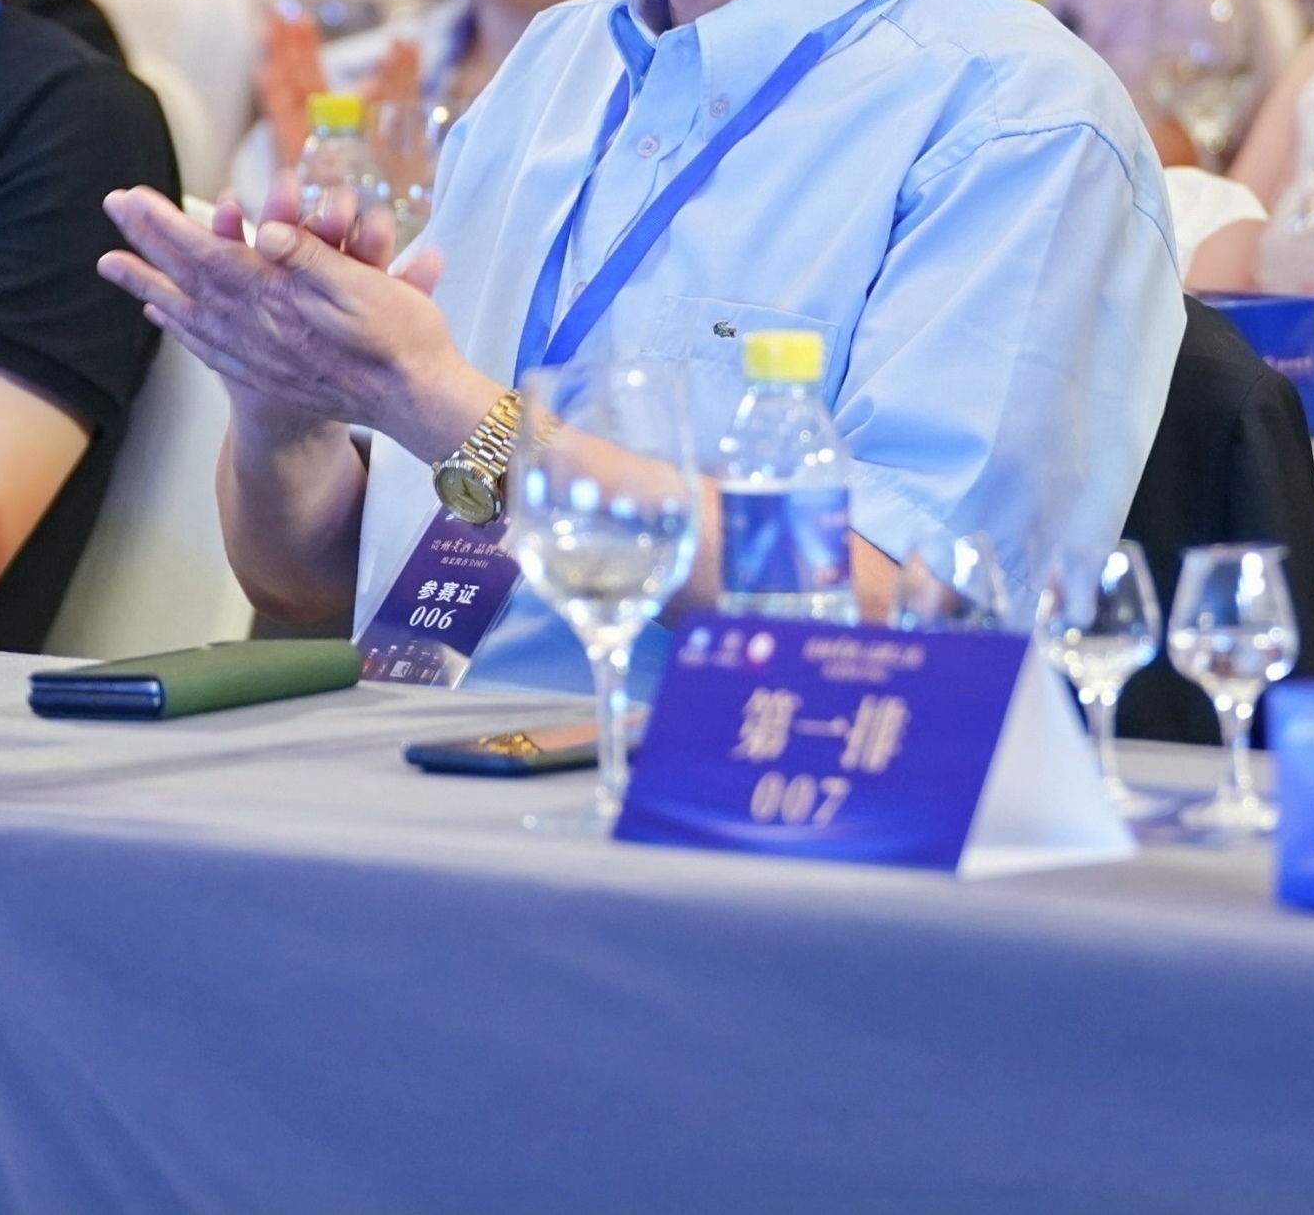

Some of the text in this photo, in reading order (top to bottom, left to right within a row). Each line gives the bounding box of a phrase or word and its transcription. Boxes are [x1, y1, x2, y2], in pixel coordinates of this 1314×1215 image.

[416, 580, 480, 605] 参赛证
[408, 605, 458, 631] 006
[728, 687, 913, 775] 第一排
[749, 771, 852, 828] 007
